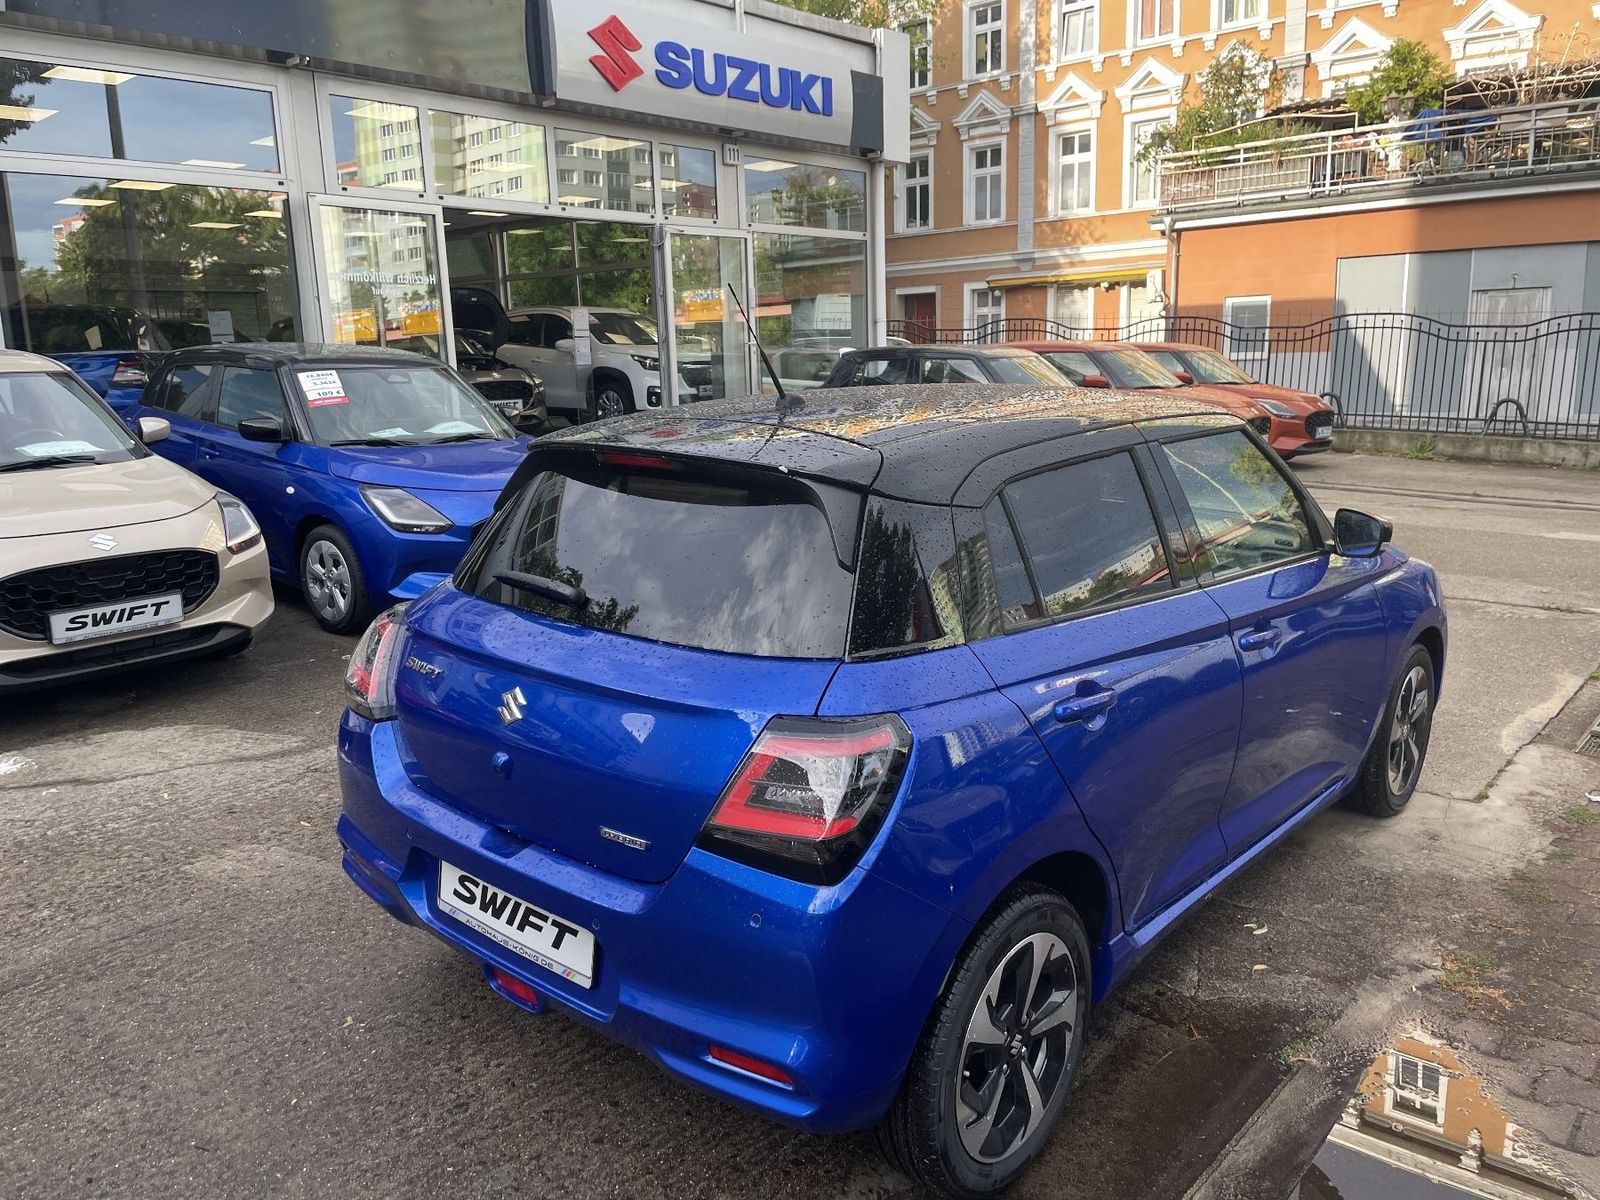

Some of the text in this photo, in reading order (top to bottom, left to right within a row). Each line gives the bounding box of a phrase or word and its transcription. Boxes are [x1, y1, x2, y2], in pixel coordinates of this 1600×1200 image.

[654, 40, 833, 117] SUZUKI
[728, 147, 740, 162] 111
[65, 600, 170, 632] SWIFT
[404, 656, 444, 678] SWIFT
[452, 873, 580, 951] SWIFT
